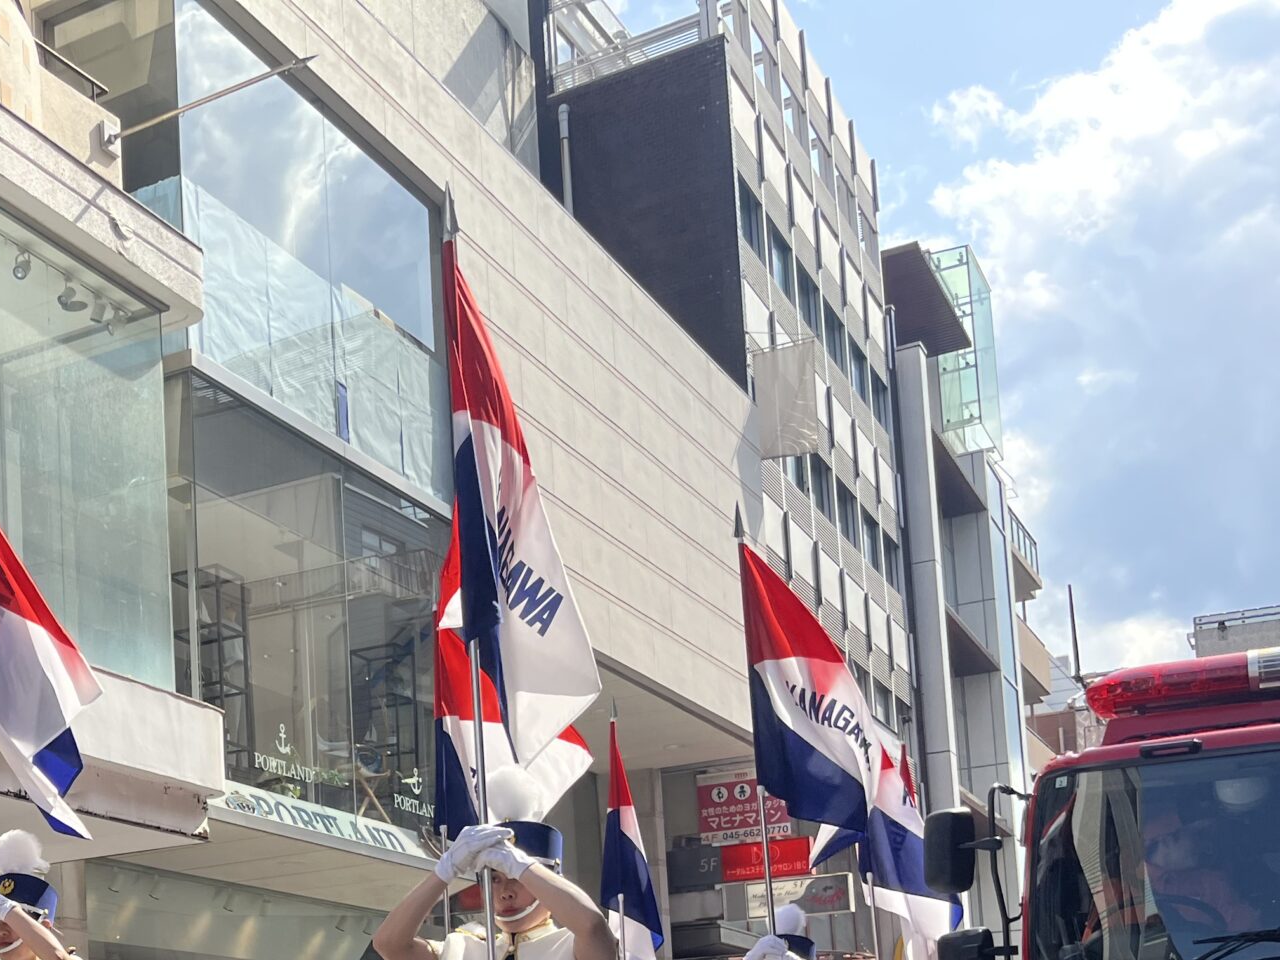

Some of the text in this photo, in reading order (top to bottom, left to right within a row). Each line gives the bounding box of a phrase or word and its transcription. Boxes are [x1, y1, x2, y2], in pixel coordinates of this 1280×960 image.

[497, 504, 564, 637] GAWA
[786, 681, 872, 771] ANAGA
[253, 751, 314, 783] PORTLAND
[393, 793, 435, 819] PORTLAN
[701, 800, 787, 817] 女性のためのヨガタジオ
[707, 809, 782, 829] マヒナマン
[249, 793, 407, 852] PORTLAND
[722, 825, 789, 840] 045-6620770
[698, 857, 719, 873] 5F
